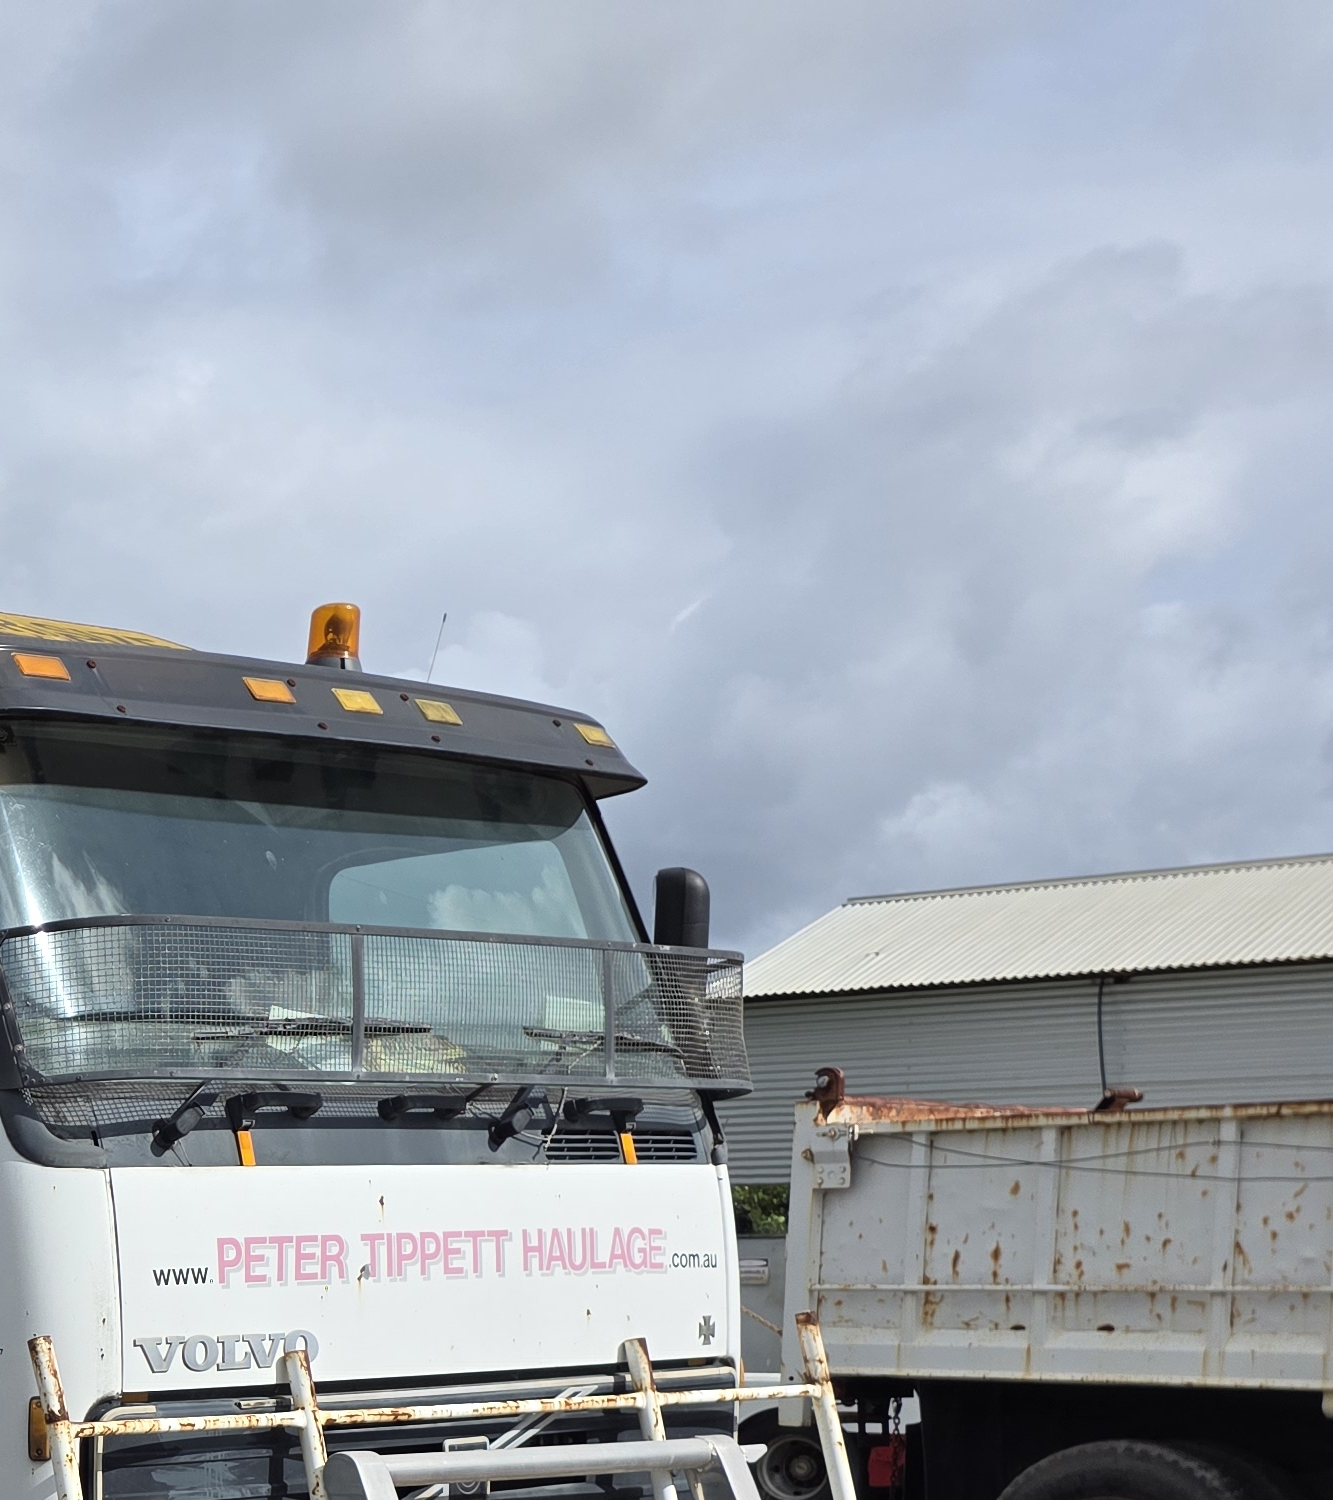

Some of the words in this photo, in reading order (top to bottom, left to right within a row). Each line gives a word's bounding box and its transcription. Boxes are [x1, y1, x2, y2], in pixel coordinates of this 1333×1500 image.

[152, 1267, 214, 1287] www.
[216, 1234, 349, 1289] PETER
[360, 1229, 512, 1283] TIPPETT
[521, 1226, 669, 1276] HAULAGE
[668, 1251, 718, 1269] .com.au
[133, 1329, 320, 1374] VOLVO
